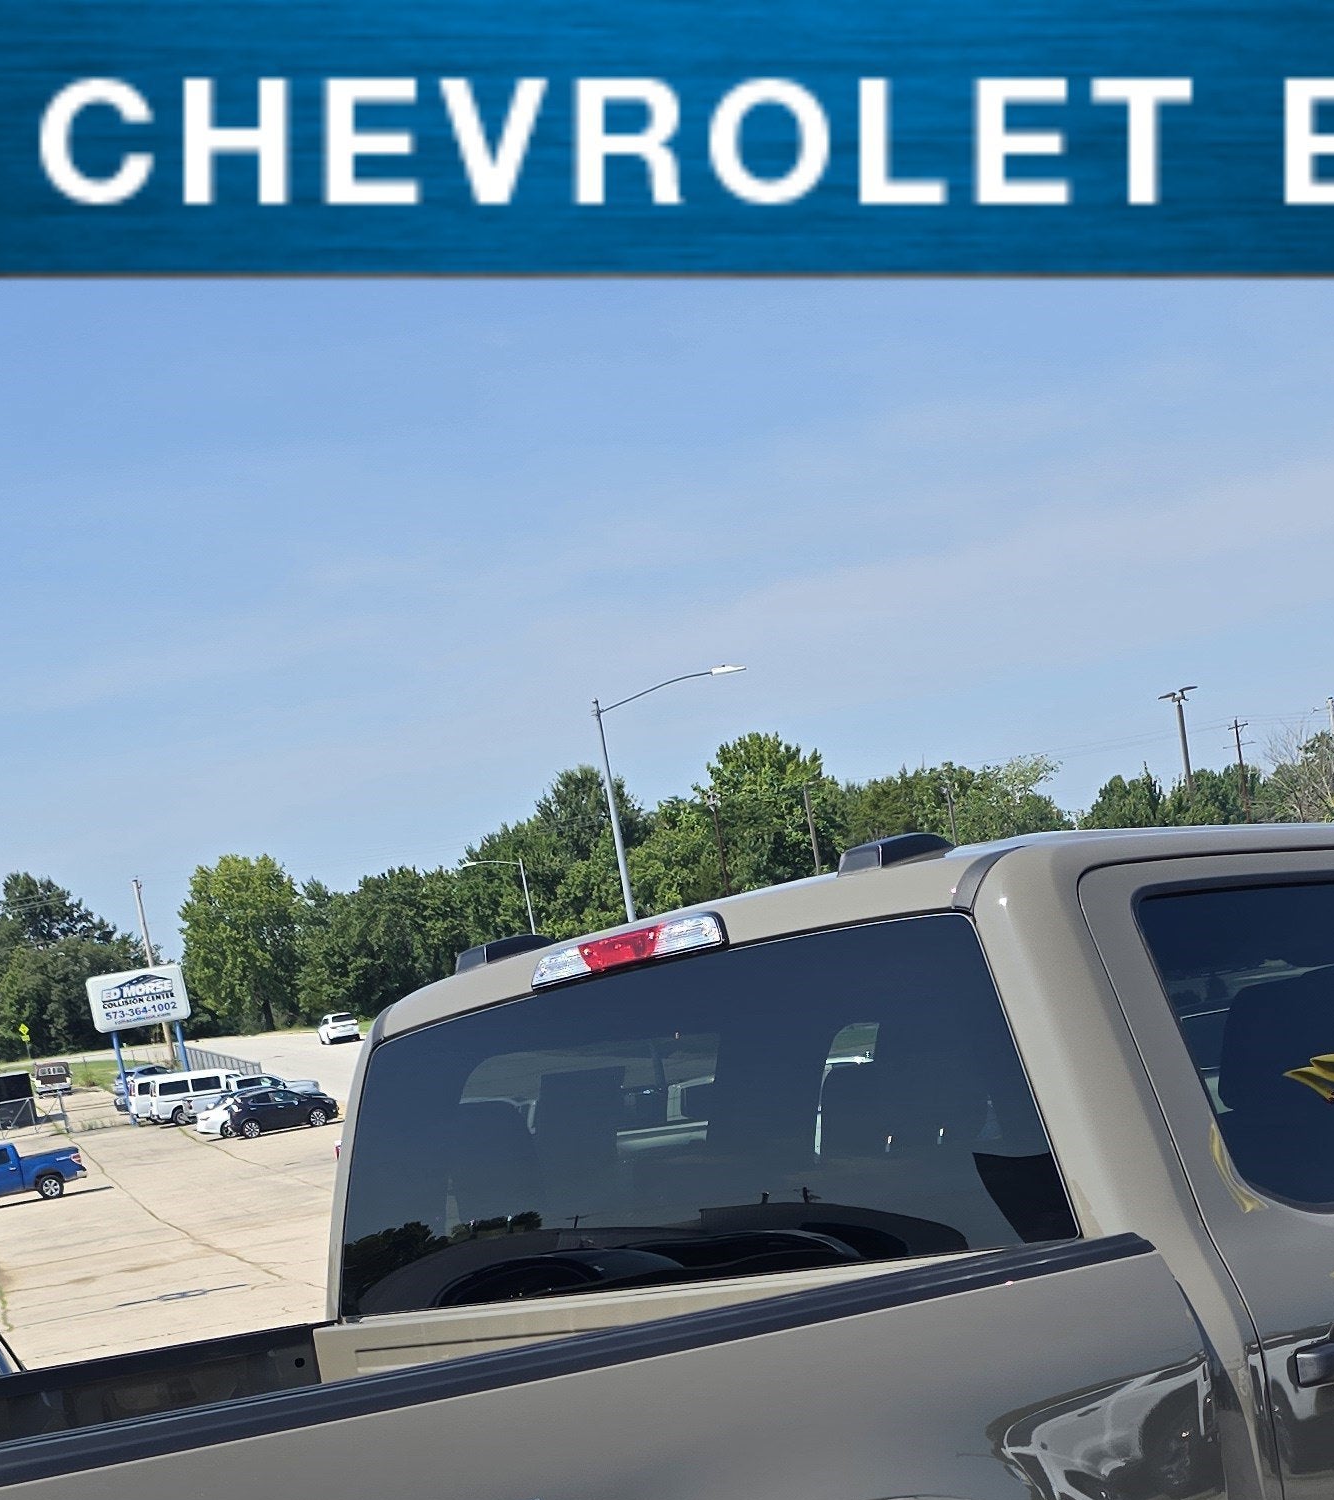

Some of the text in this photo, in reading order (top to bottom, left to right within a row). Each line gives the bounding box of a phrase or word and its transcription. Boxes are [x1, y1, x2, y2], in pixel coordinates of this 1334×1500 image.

[102, 978, 173, 1002] ED MORSE
[103, 992, 176, 1010] COLLISION CENTER
[105, 1001, 178, 1021] 573-364-1002
